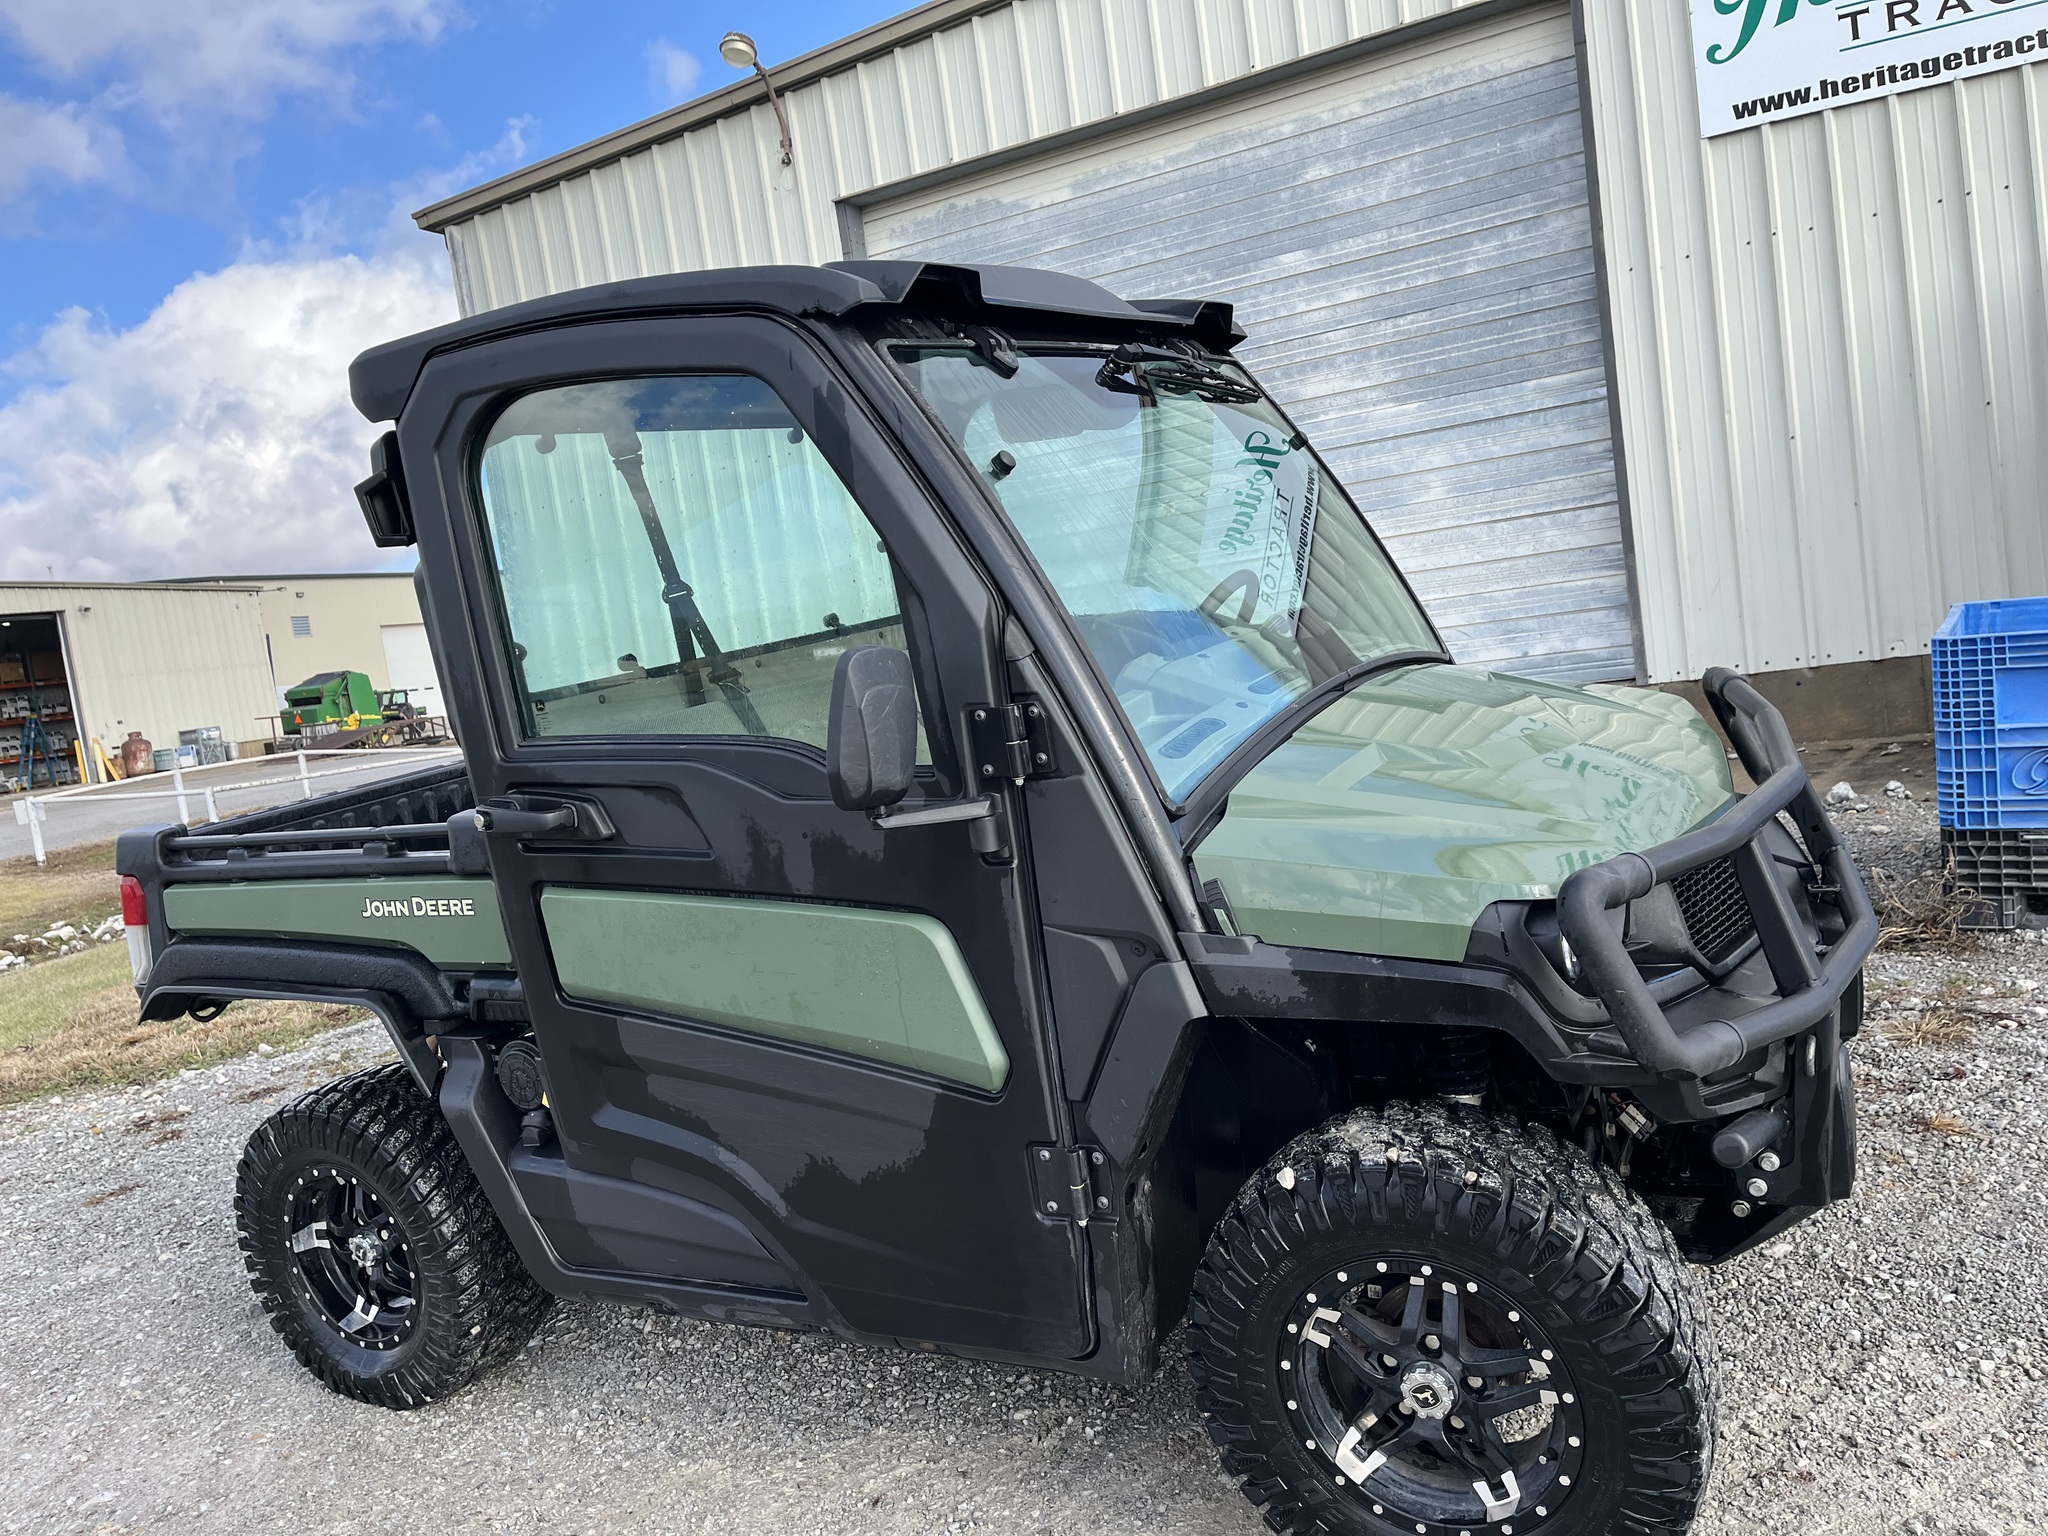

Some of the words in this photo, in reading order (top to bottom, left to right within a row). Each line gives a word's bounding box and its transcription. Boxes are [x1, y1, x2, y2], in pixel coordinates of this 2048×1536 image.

[1837, 0, 2017, 42] TRA
[362, 897, 410, 917] JOHN
[410, 896, 475, 917] DEERE
